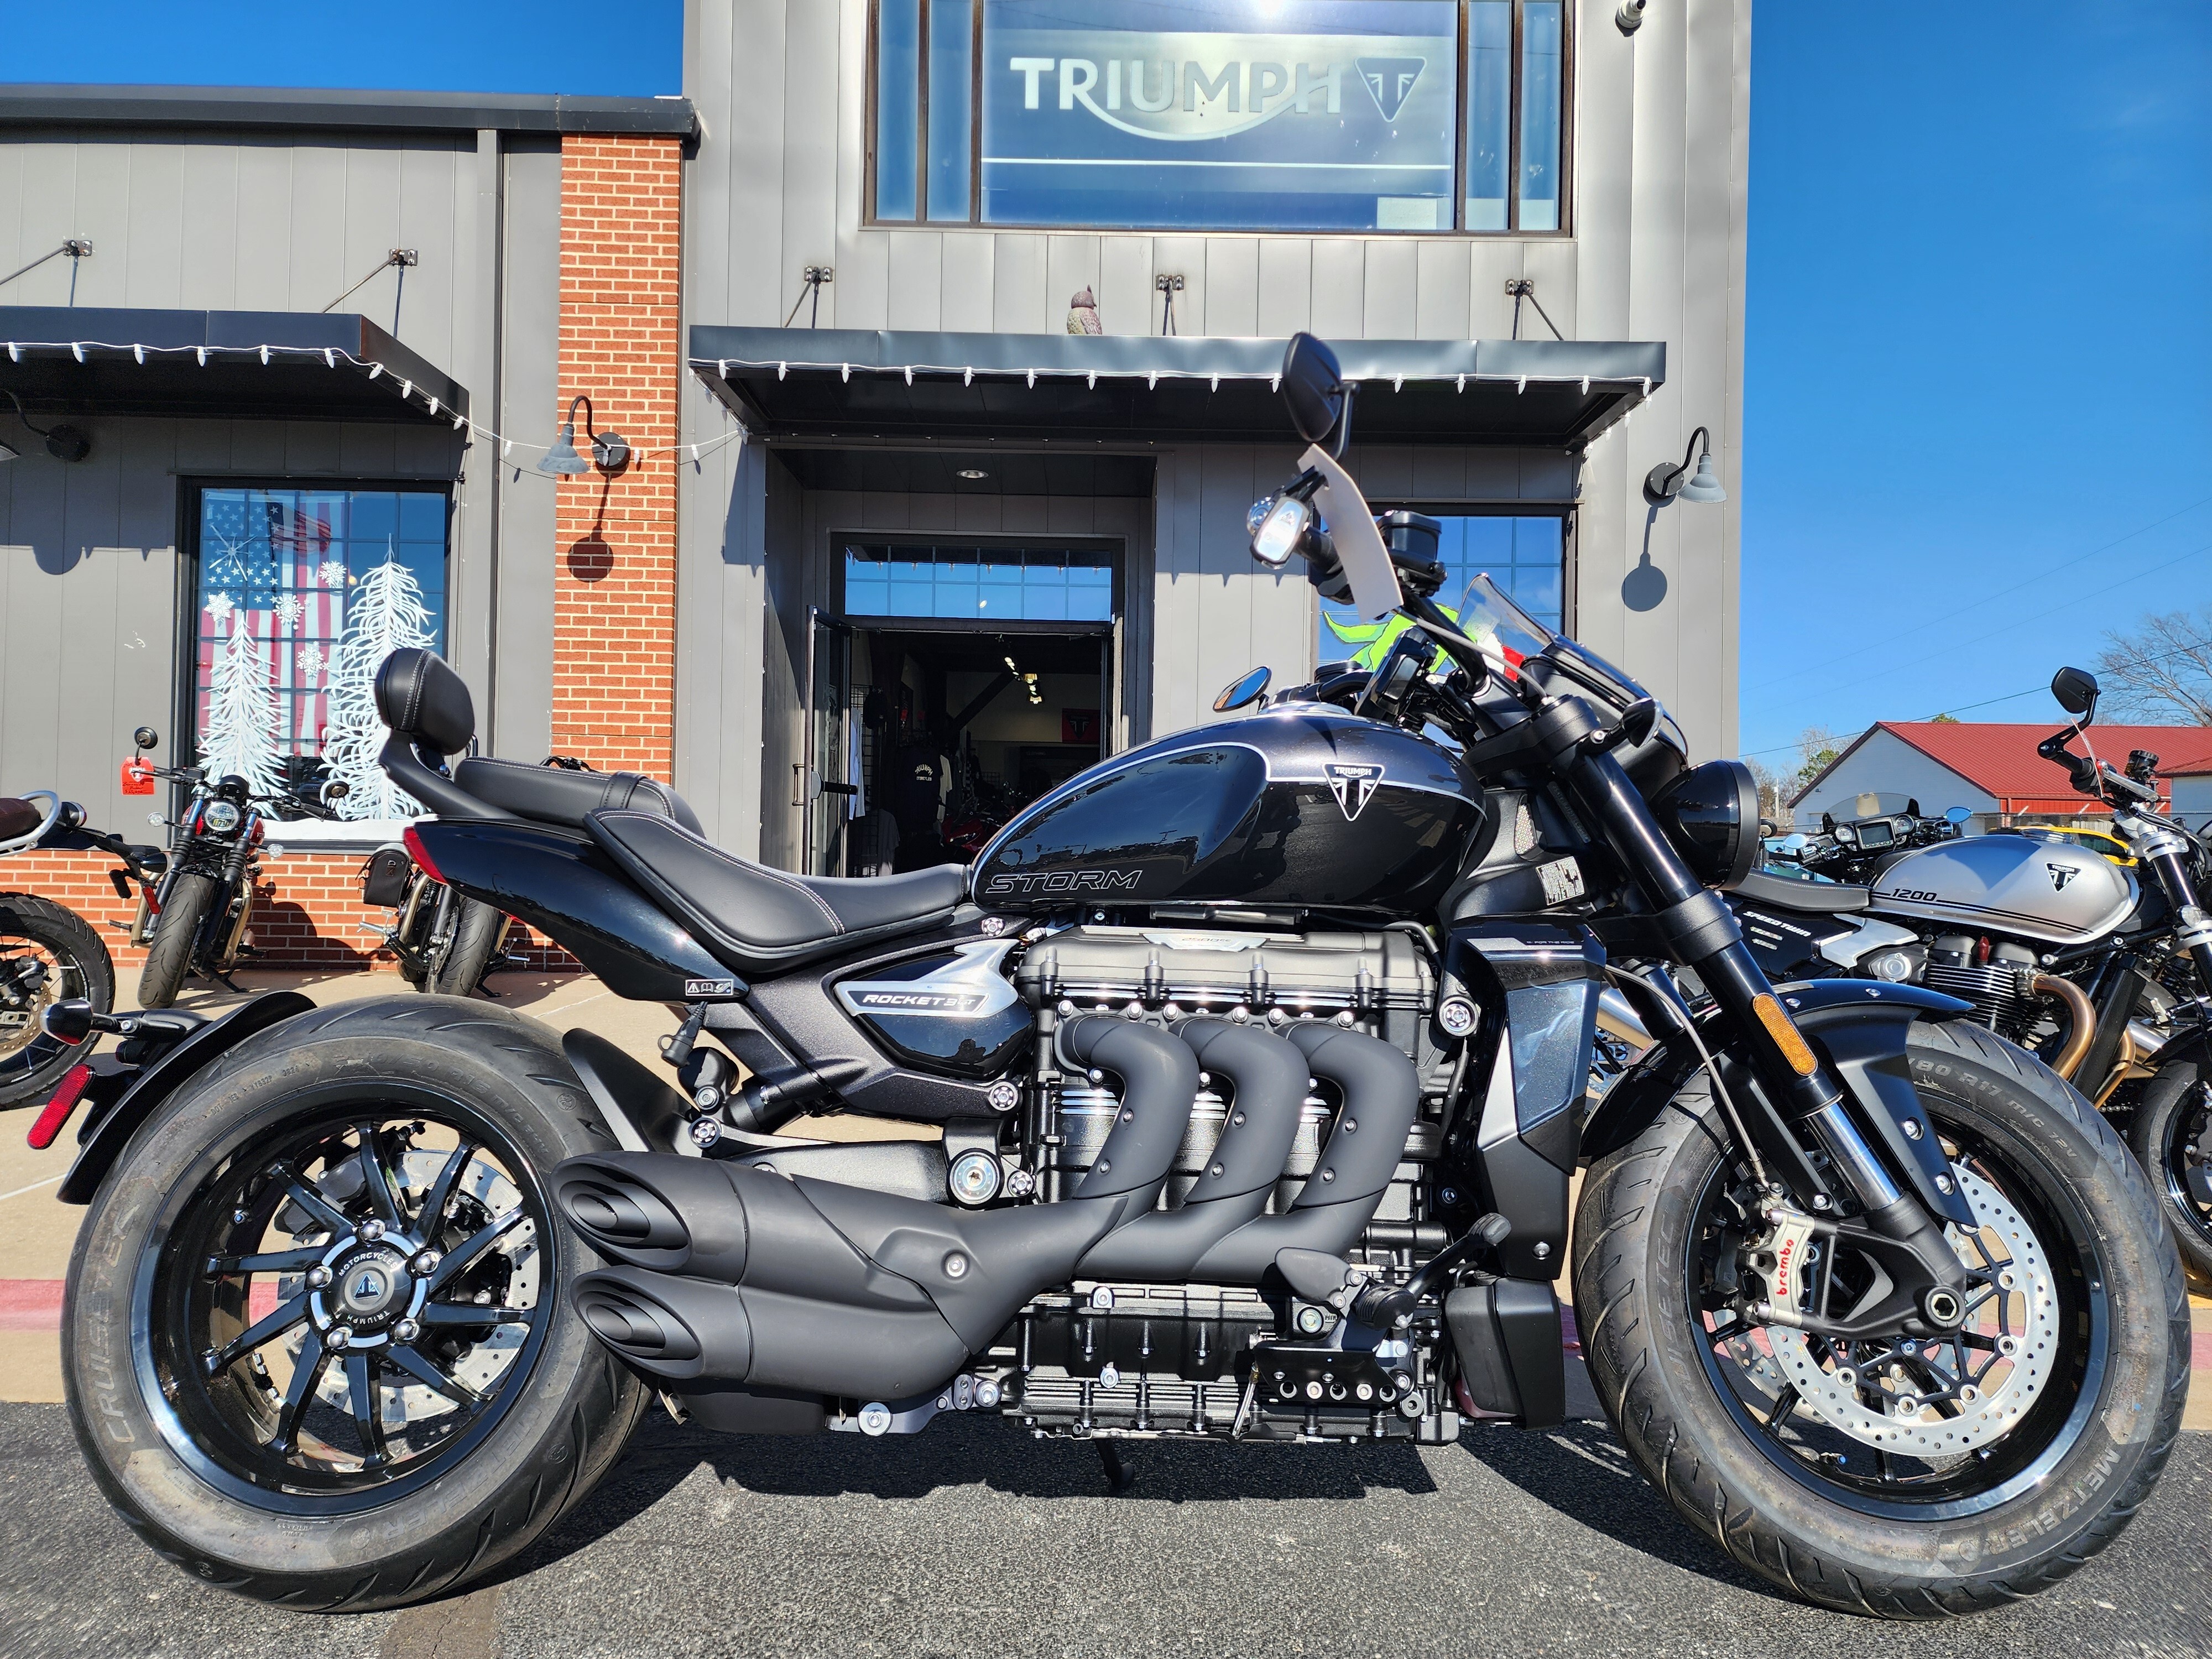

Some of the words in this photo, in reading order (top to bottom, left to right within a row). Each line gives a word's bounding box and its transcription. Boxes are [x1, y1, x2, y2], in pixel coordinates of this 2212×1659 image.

[1010, 57, 1341, 140] TRIUMPH
[1333, 766, 1372, 778] TRIUMPH
[984, 870, 1143, 894] STORM
[1892, 888, 1937, 901] 1200
[1743, 911, 1782, 926] SPEED
[862, 994, 946, 1006] ROCKET
[1957, 1071, 2004, 1098] R17
[338, 1251, 398, 1277] MOTORCYCLES
[1776, 1238, 1794, 1296] brembo
[346, 1310, 392, 1325] TRIUMPH
[1989, 1446, 2122, 1556] METZELER
